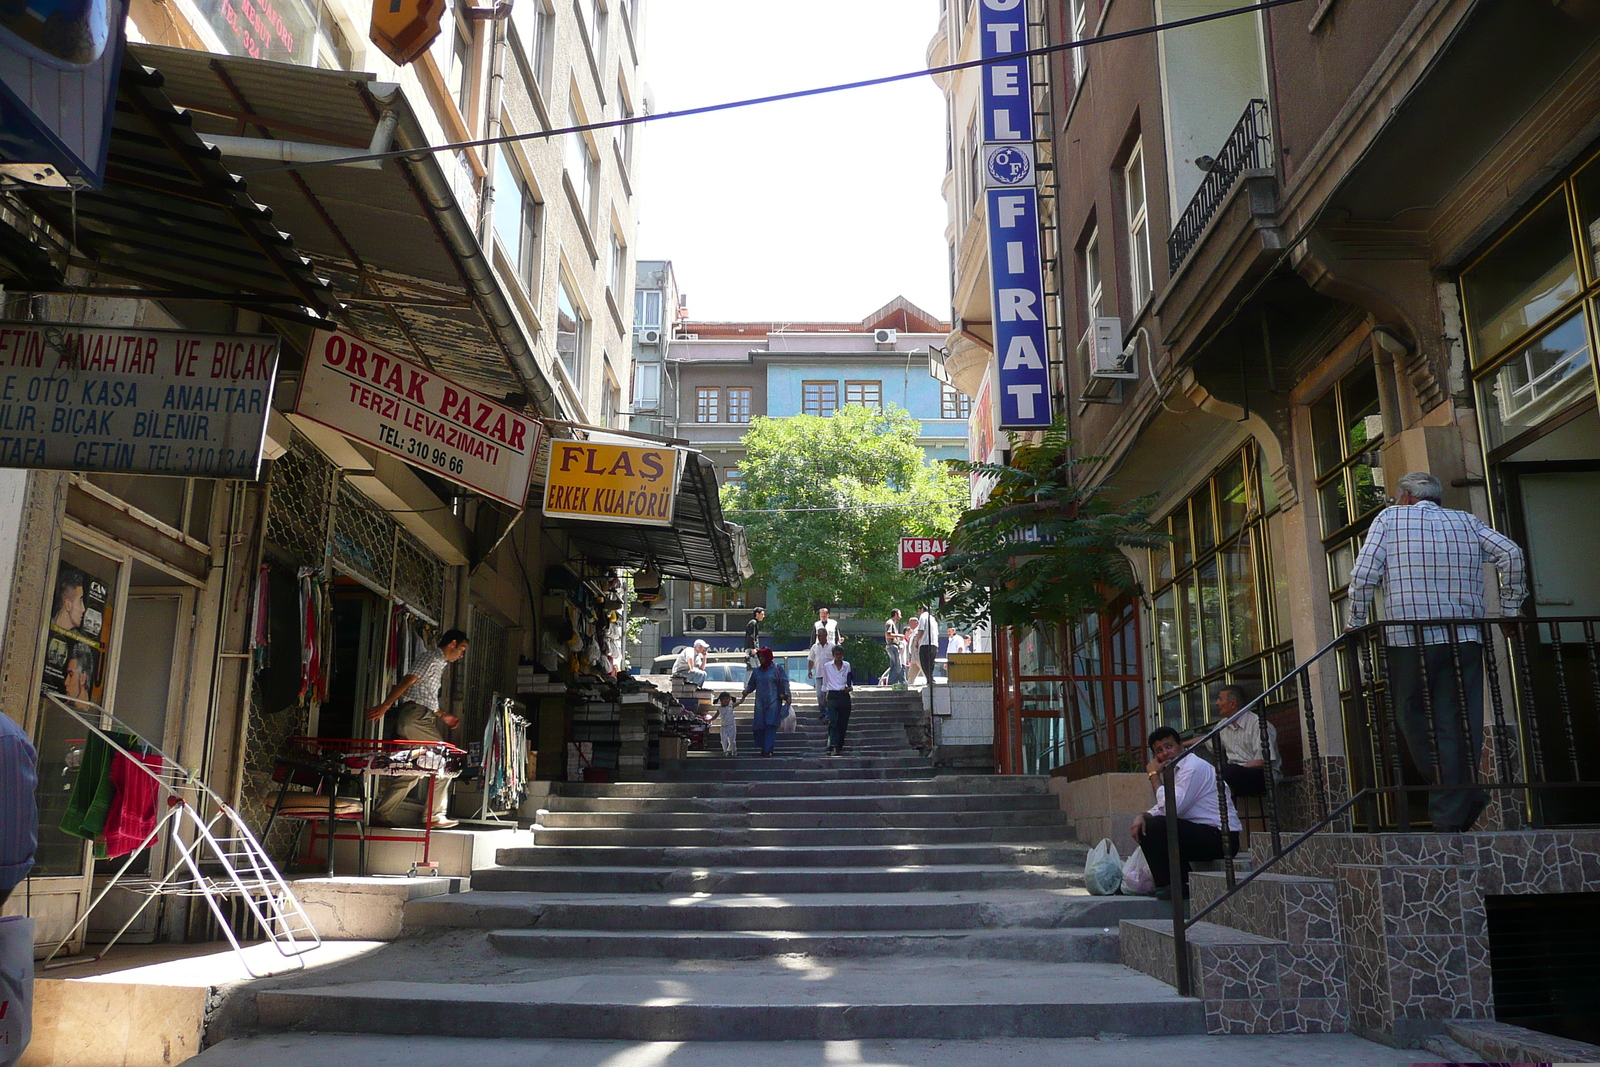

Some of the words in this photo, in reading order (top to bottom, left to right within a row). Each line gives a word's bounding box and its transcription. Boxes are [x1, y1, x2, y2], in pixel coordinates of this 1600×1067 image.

[257, 0, 293, 52] UAFÖRÜ
[998, 196, 1043, 419] FIRAT
[57, 333, 158, 374] ANAHTAR
[174, 339, 201, 376] VE
[211, 342, 274, 383] BIÇAK
[27, 376, 72, 405] OTO,
[81, 380, 137, 407] KASA
[325, 336, 429, 404] ORTAK
[439, 386, 525, 450] PAZAR
[349, 383, 401, 420] TERZİ
[403, 408, 499, 465] LEVAZIMATI
[379, 424, 405, 449] TEL:
[407, 438, 428, 459] 310
[432, 449, 446, 468] 96
[449, 456, 464, 474] 66
[0, 437, 46, 465] TAFA
[560, 446, 664, 482] FLAŞ
[548, 485, 591, 511] ERKEK
[593, 485, 671, 518] KUAFÖRÜ
